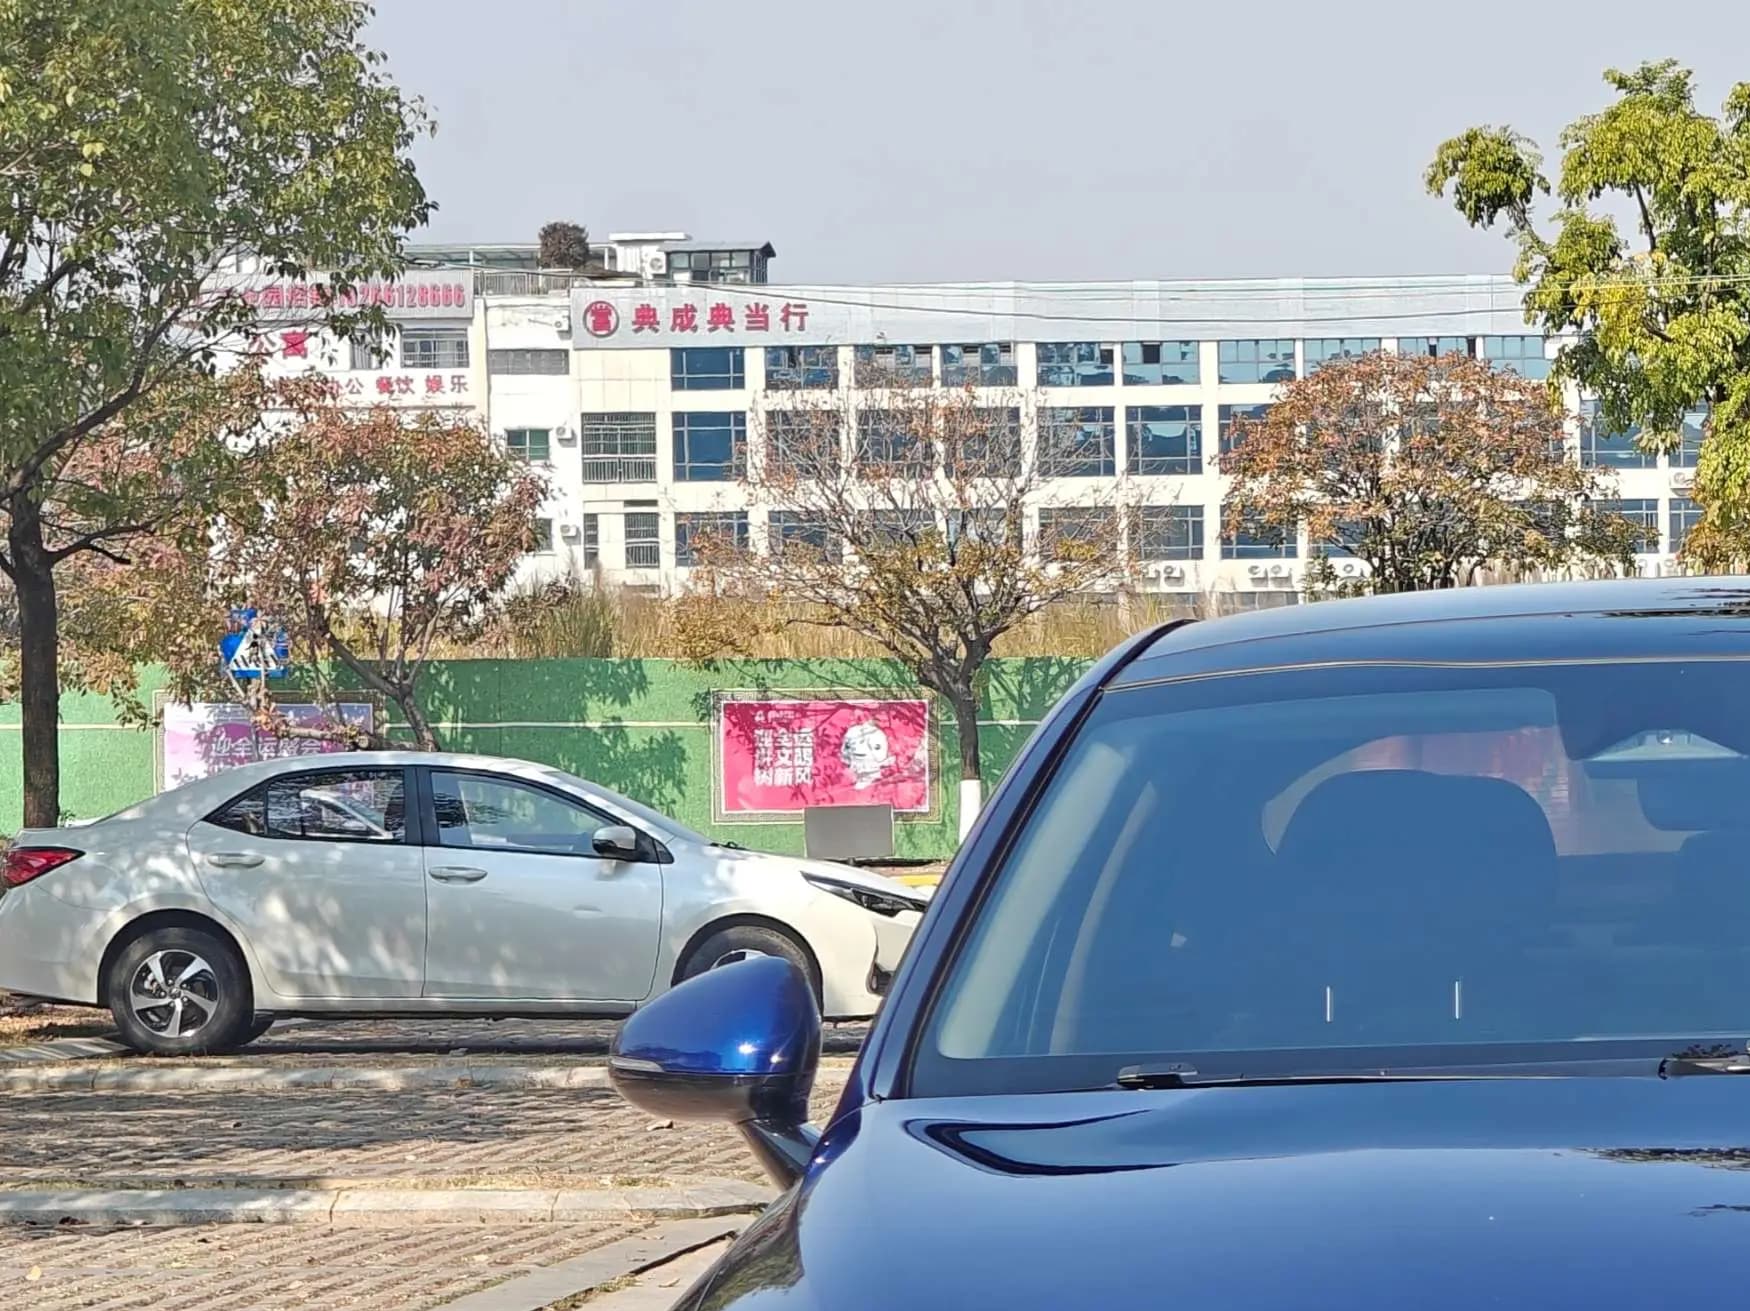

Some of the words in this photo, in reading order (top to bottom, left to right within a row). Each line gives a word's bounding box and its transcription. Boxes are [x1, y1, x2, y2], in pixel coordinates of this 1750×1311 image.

[632, 302, 809, 333] 典成典当行
[425, 375, 469, 395] 娱乐
